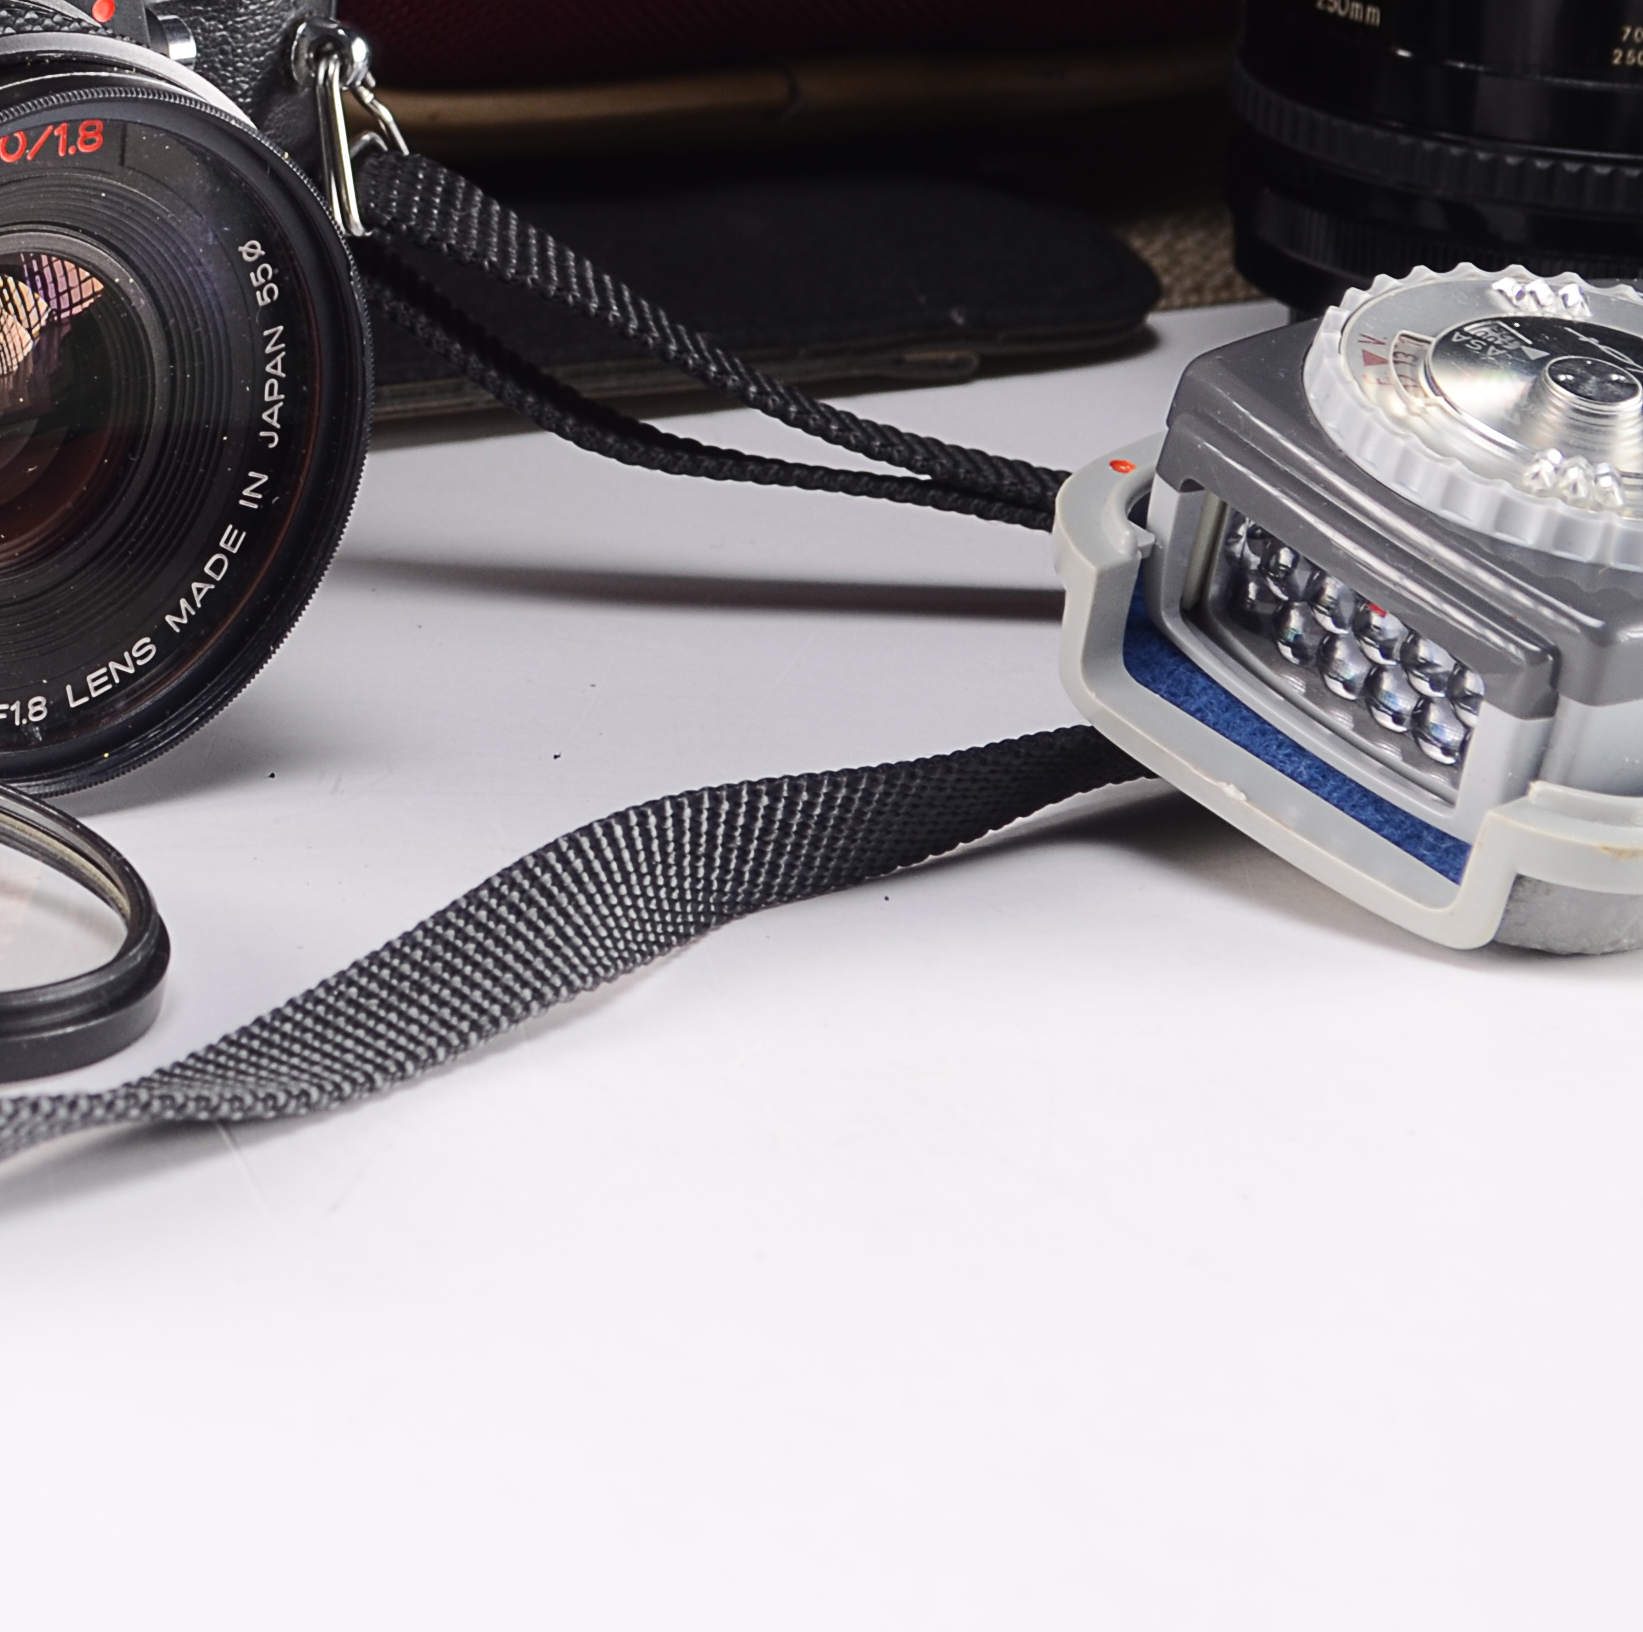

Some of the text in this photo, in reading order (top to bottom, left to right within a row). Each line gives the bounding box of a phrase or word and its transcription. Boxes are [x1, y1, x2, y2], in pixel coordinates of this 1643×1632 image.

[64, 636, 159, 708] LENS
[163, 524, 248, 633] MADE
[239, 471, 270, 510] IN
[258, 324, 286, 449] JAPAN
